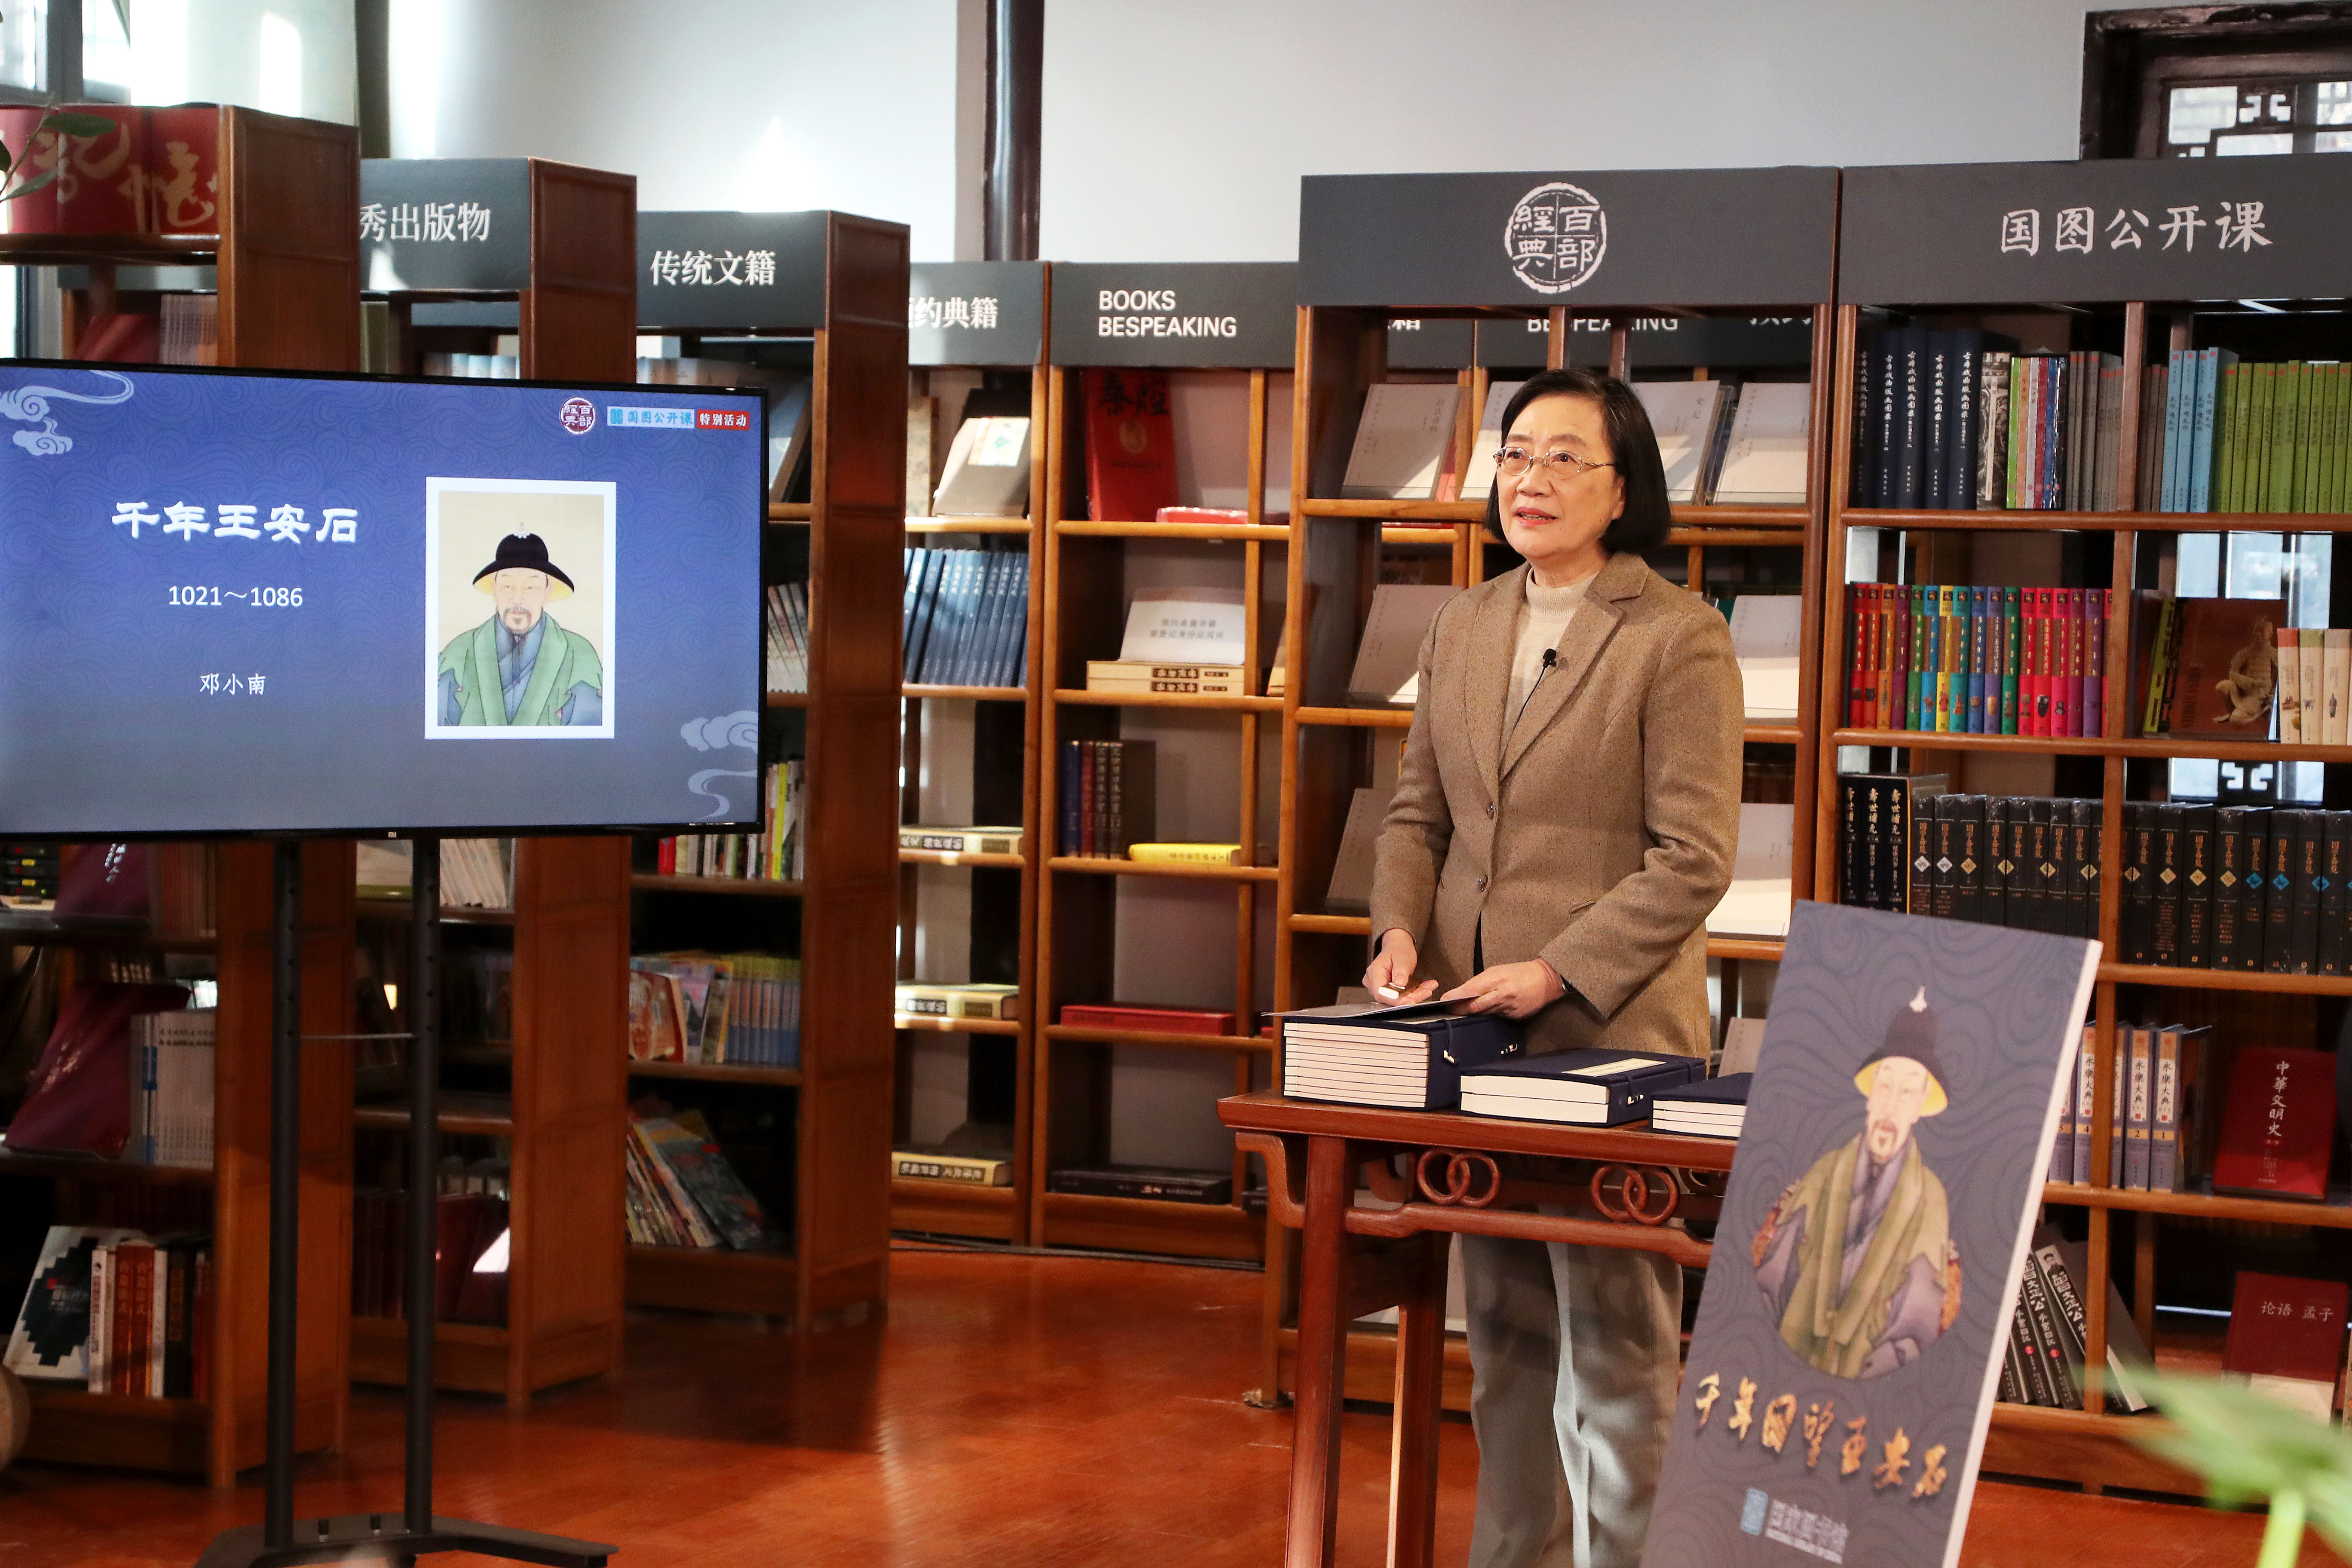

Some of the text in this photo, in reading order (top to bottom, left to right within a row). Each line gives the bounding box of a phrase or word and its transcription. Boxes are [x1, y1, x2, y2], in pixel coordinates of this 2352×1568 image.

[360, 202, 491, 242] 秀出版物
[2001, 201, 2273, 257] 国图公开课
[650, 249, 776, 285] 传统文籍
[1099, 290, 1176, 312] BOOKS
[1099, 316, 1237, 338] BESPEAKING
[628, 410, 694, 425] 国图公开课
[699, 413, 747, 426] 特别活动
[112, 501, 358, 545] 千年王安石
[199, 673, 266, 696] 邓小南
[2268, 1060, 2291, 1137] 中華文明史
[2261, 1301, 2333, 1322] 论语 孟子
